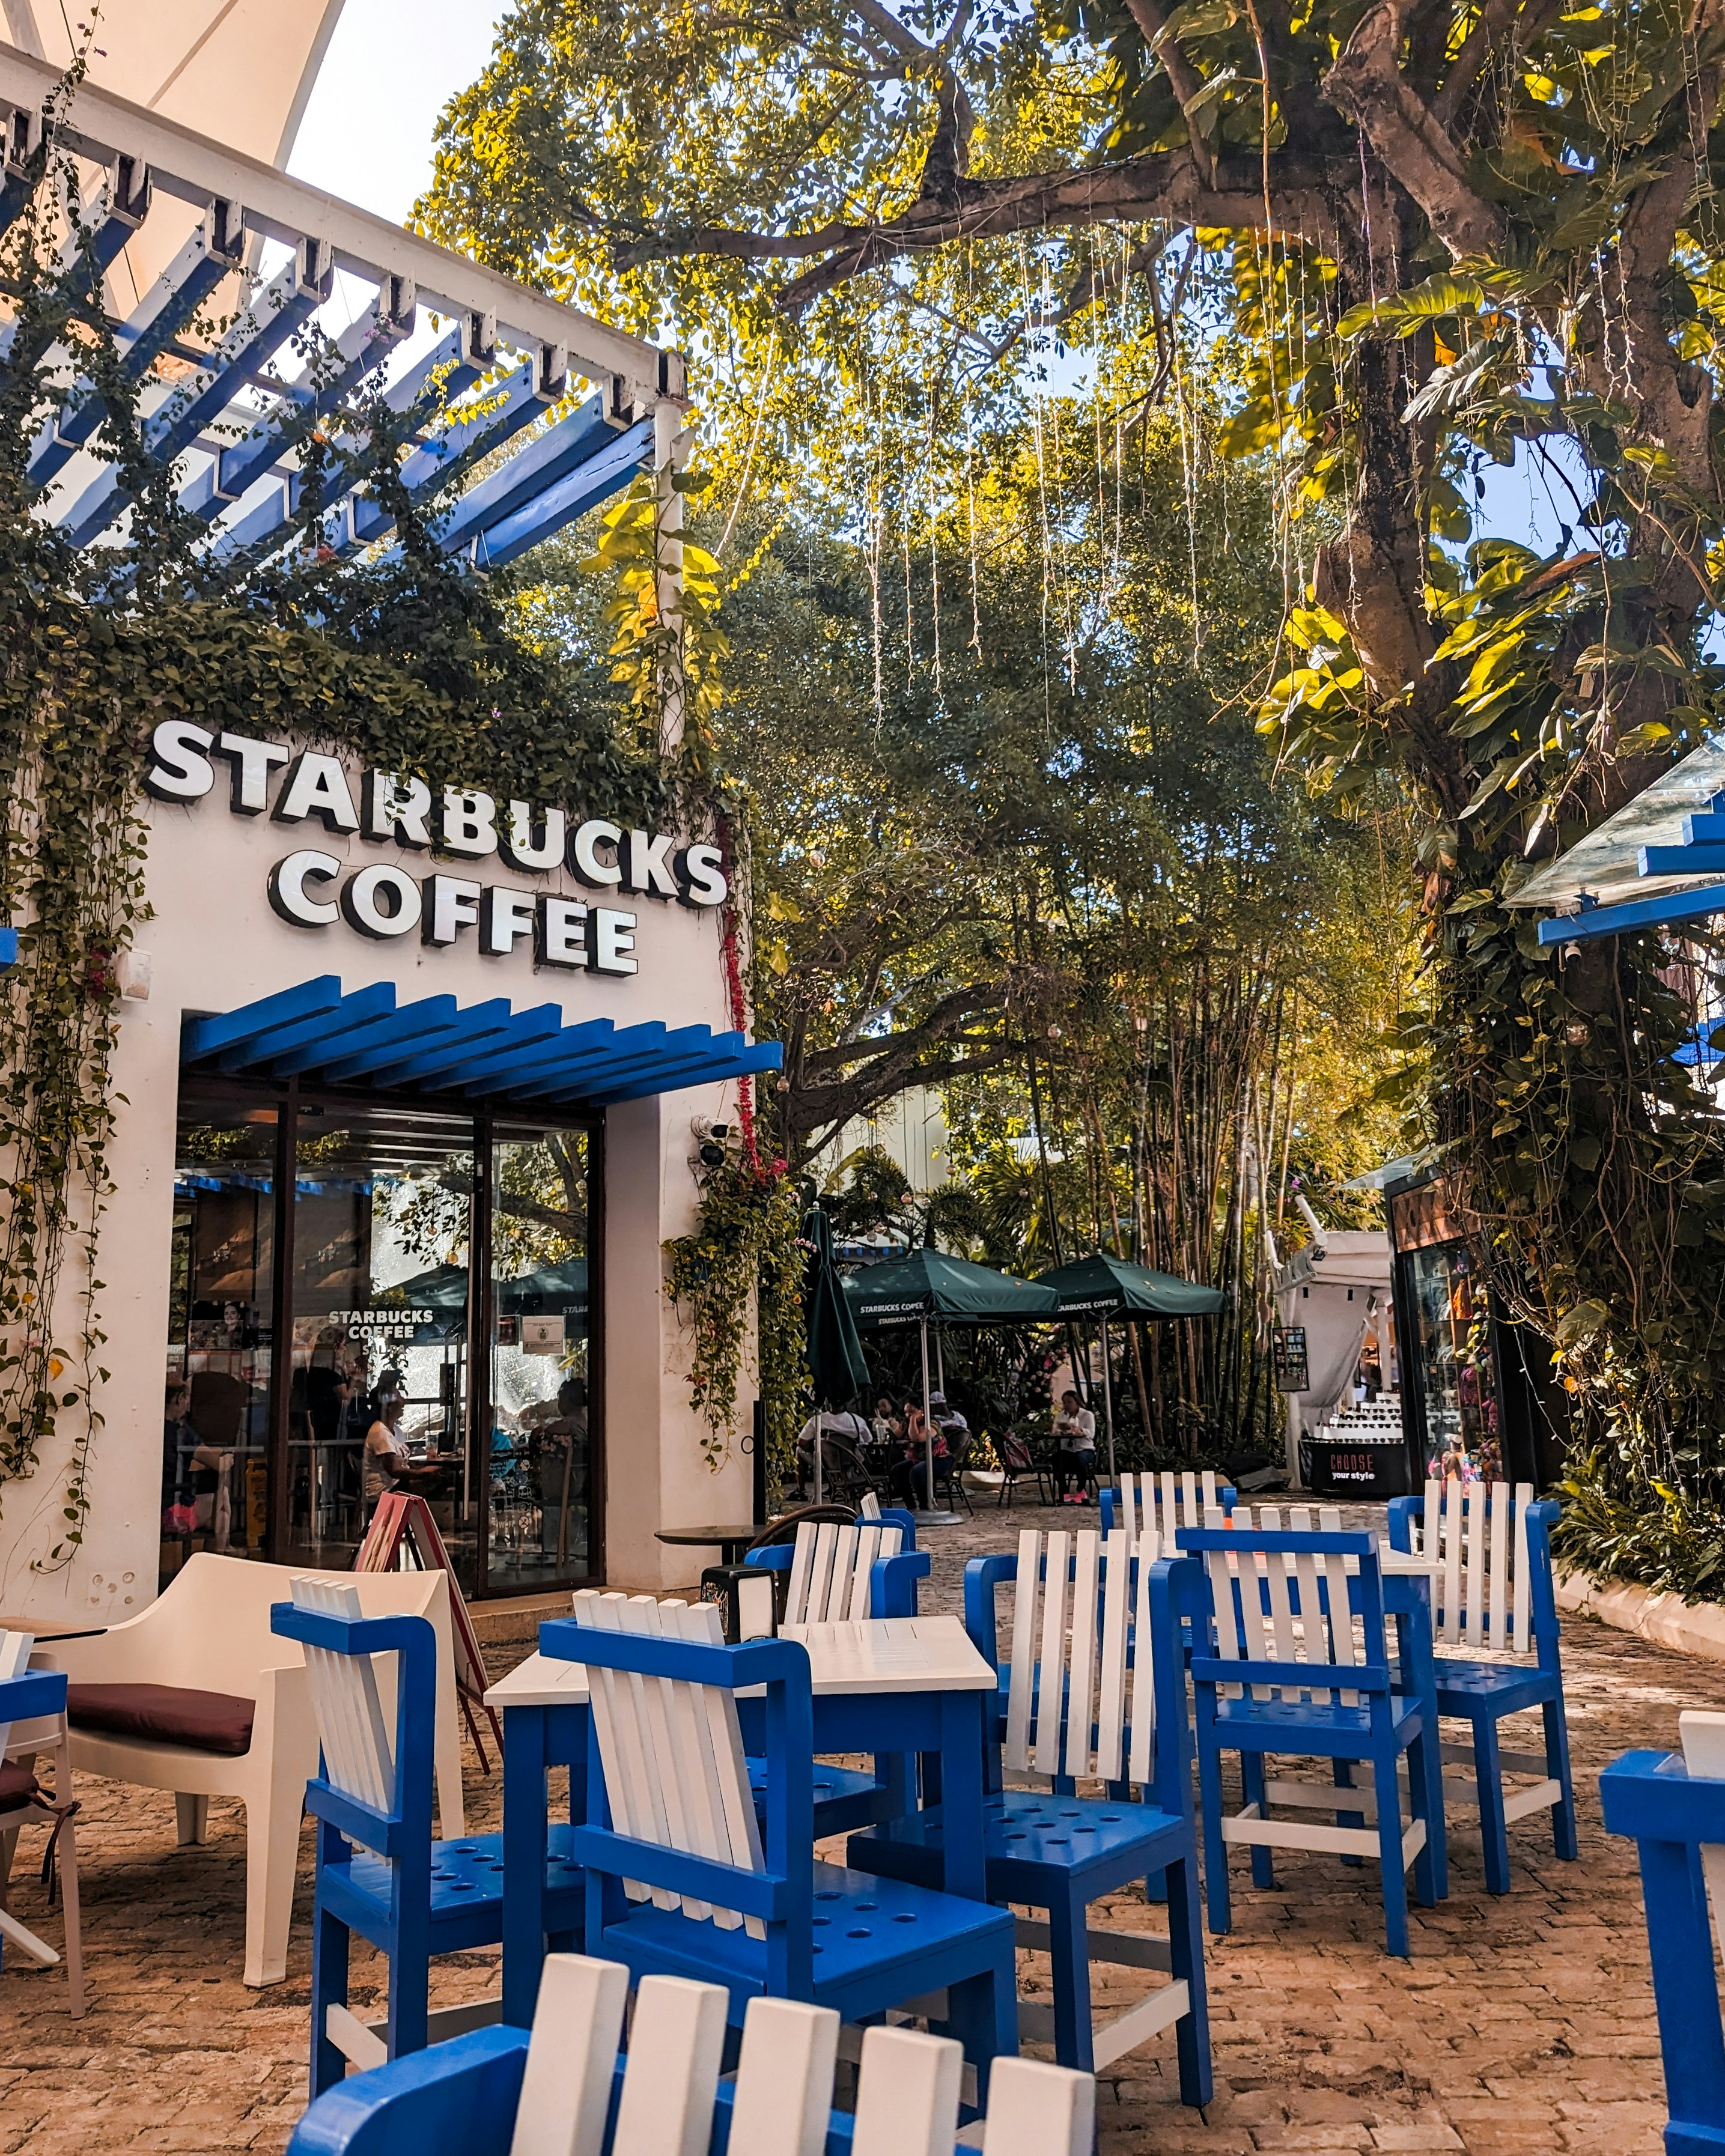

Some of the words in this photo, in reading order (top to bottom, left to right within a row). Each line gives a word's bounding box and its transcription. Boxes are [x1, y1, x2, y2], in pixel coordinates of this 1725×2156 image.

[144, 720, 728, 907] STARBUCKS
[268, 849, 638, 976] COFFEE
[860, 1304, 900, 1314] STARBUCKS
[1094, 1299, 1118, 1308] COFFEE
[329, 1310, 433, 1324] STARBUCKS
[348, 1325, 414, 1339] COFFEE
[1330, 1454, 1374, 1471] CHOOSE
[1332, 1472, 1350, 1480] your
[1351, 1471, 1375, 1481] style
